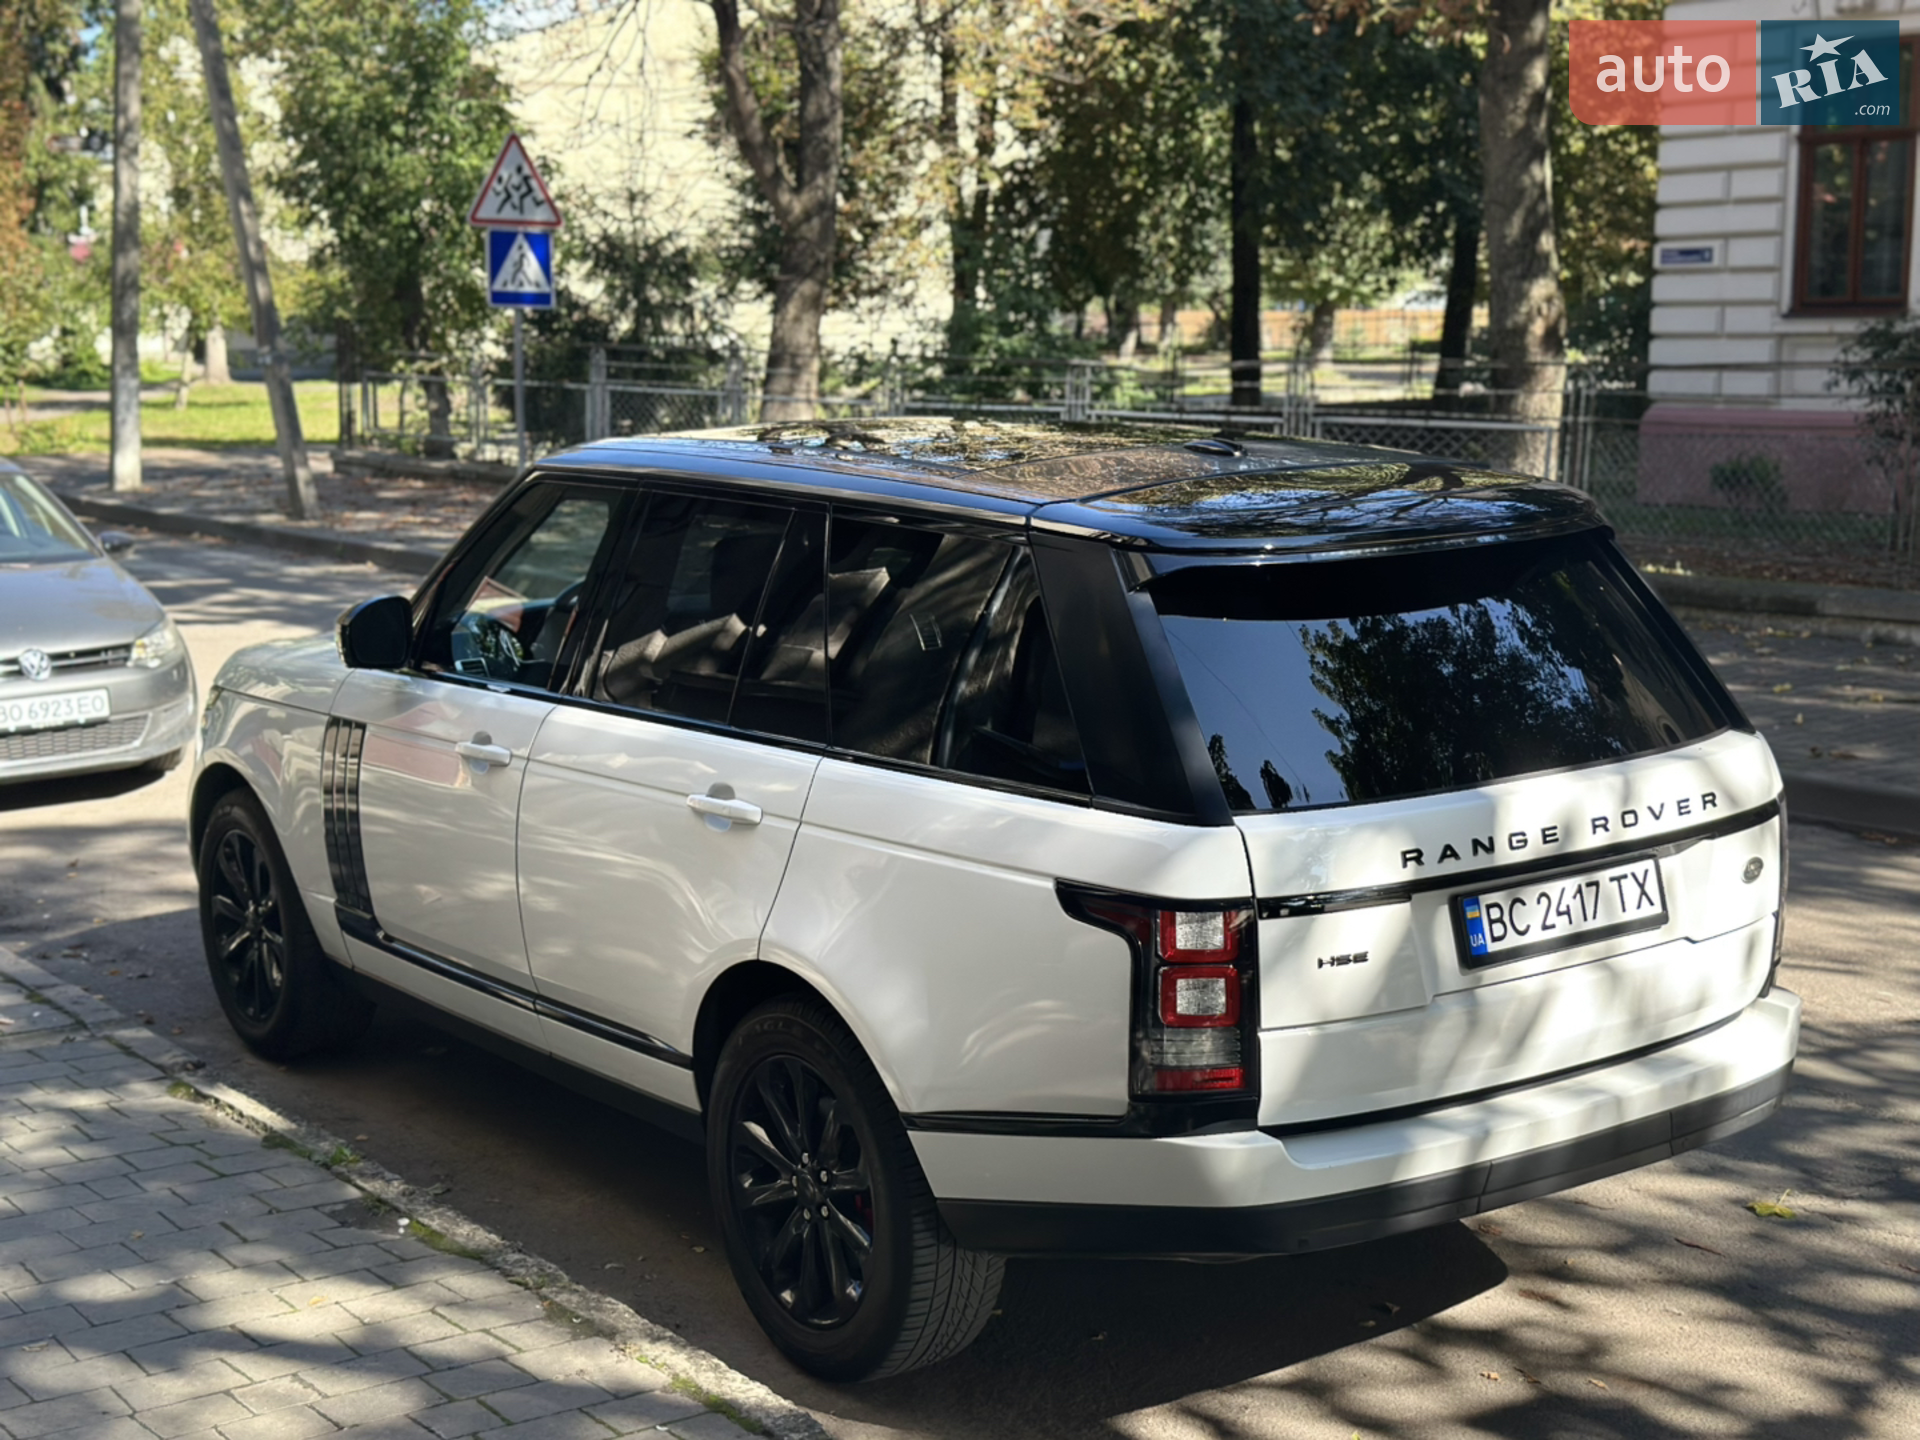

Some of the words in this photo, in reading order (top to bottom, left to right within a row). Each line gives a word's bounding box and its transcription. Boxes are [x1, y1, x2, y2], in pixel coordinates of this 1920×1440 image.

[28, 697, 74, 720] 6923
[77, 694, 105, 716] EO
[1400, 825, 1559, 868] RANGE
[1591, 791, 1718, 835] ROVER
[1485, 897, 1531, 943] BC
[1536, 879, 1600, 931] 2417
[1609, 868, 1655, 913] TX
[1469, 933, 1486, 948] UA
[1317, 950, 1369, 969] HSE
